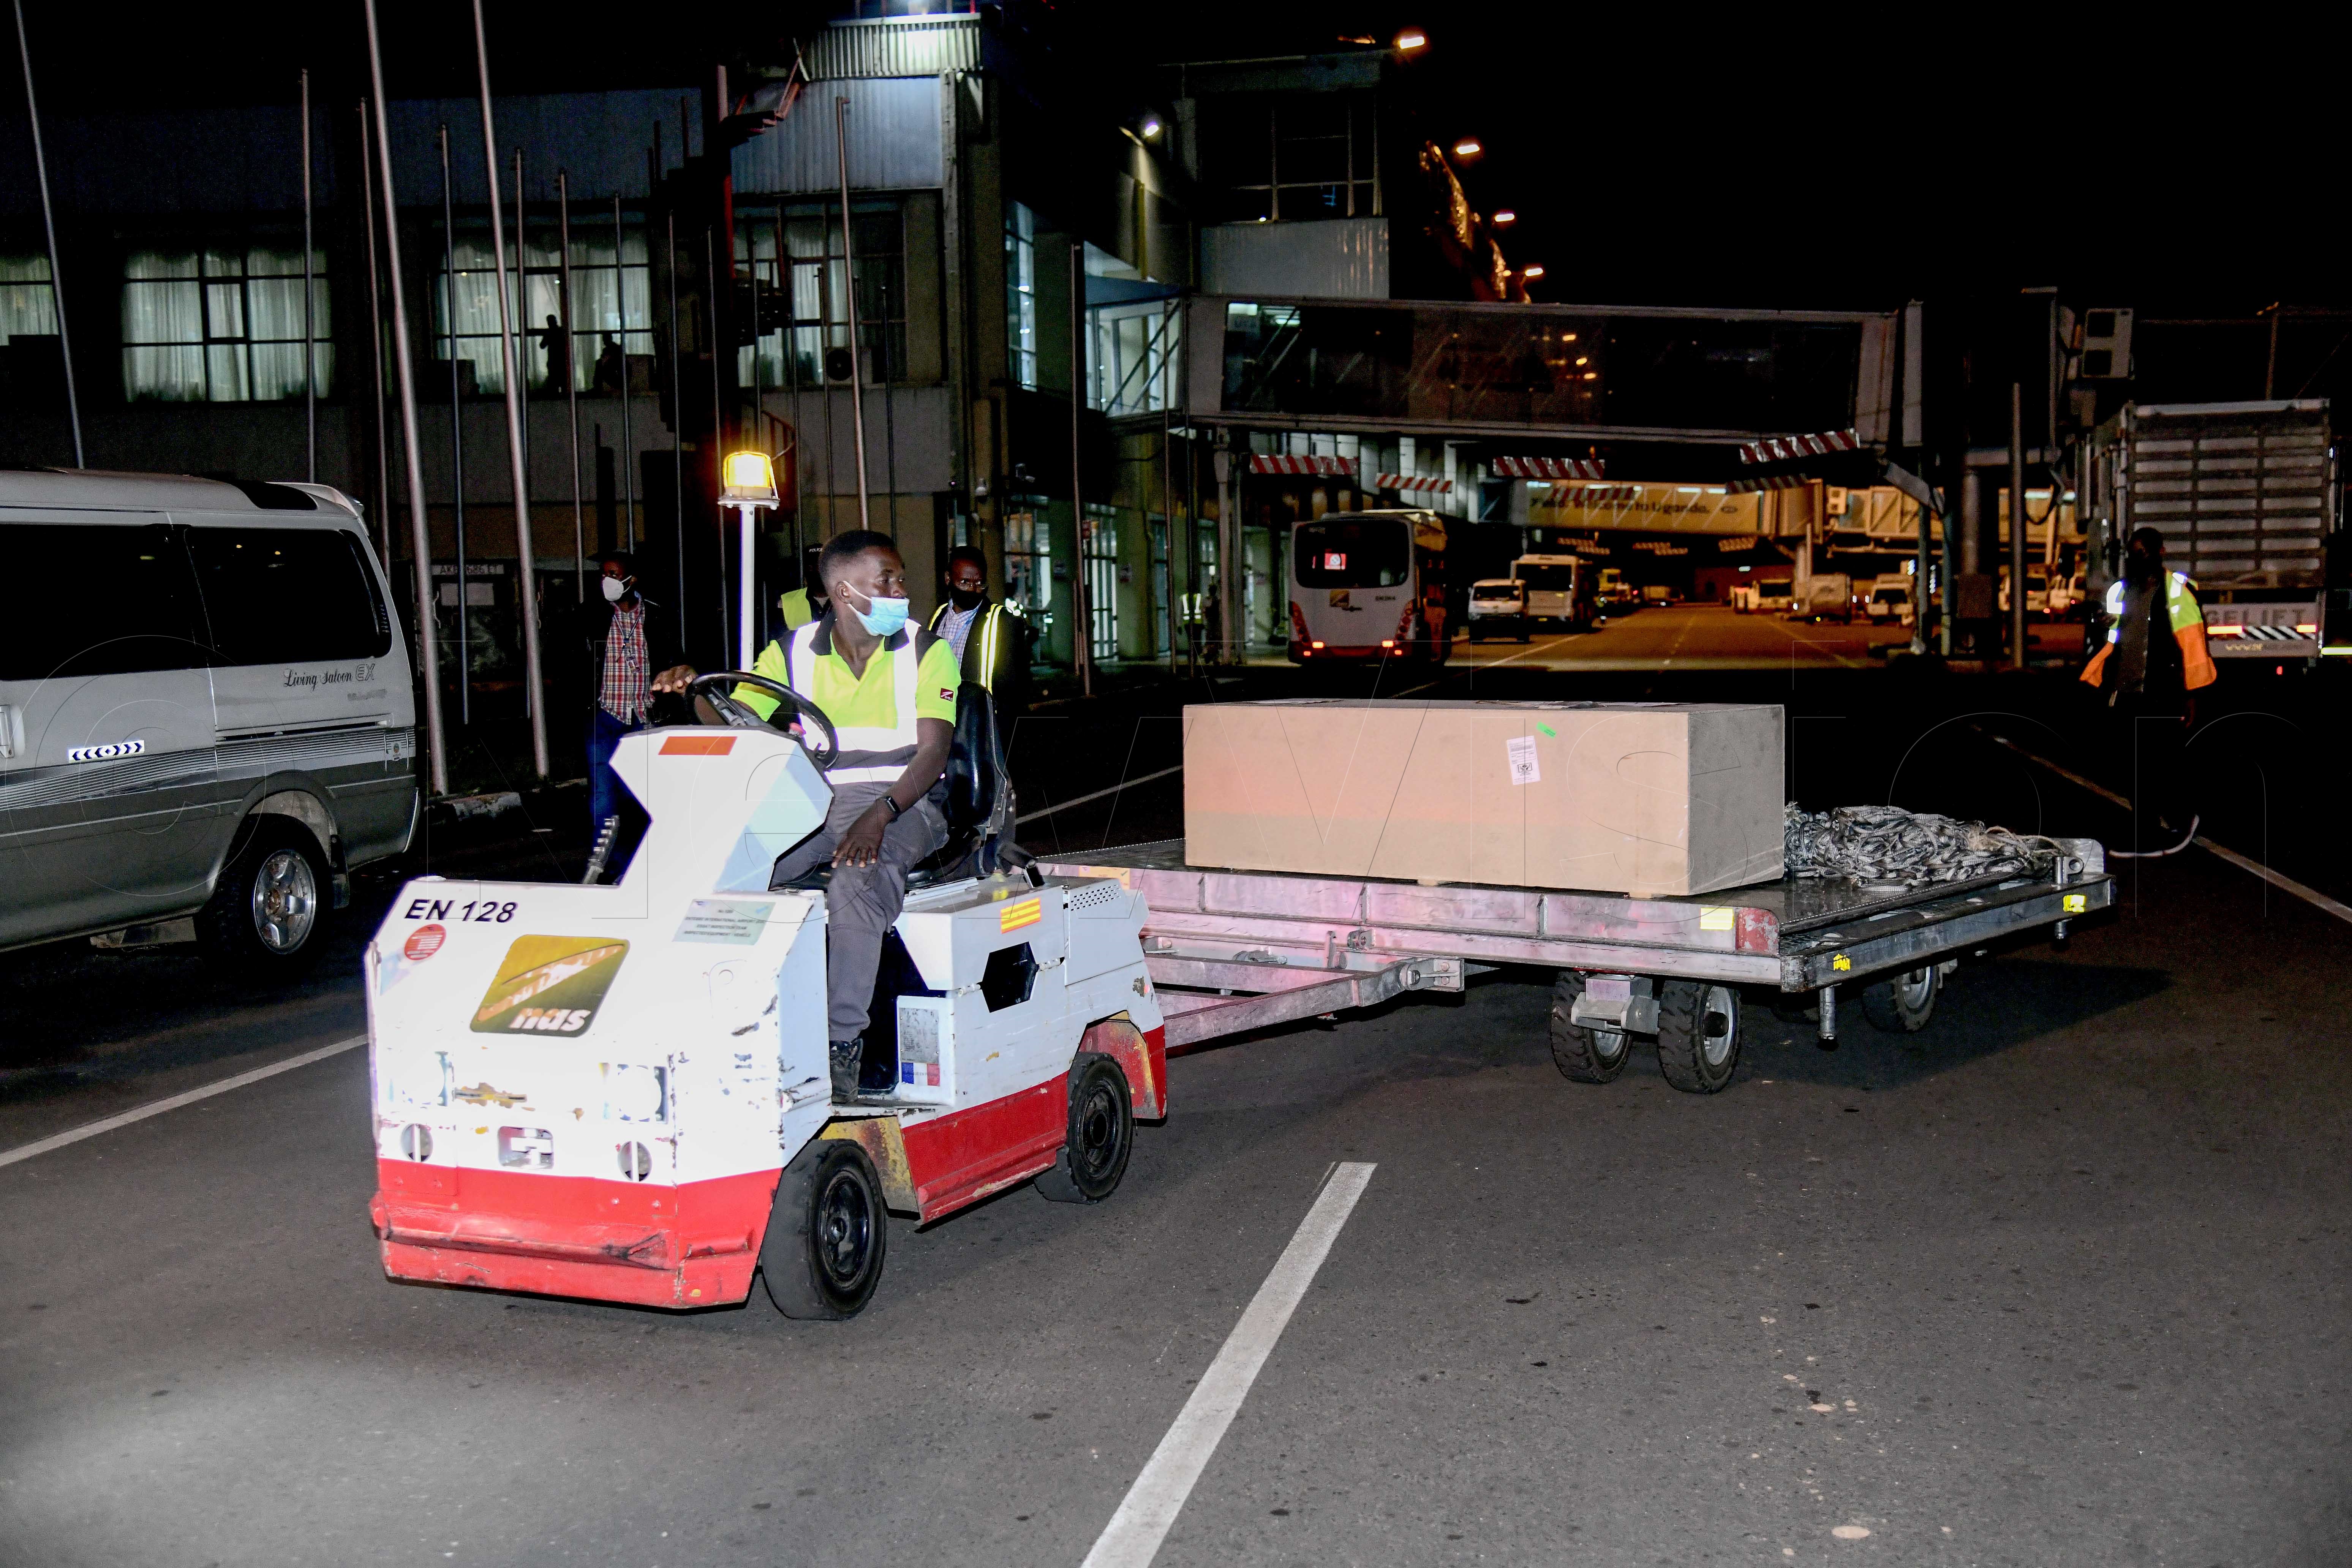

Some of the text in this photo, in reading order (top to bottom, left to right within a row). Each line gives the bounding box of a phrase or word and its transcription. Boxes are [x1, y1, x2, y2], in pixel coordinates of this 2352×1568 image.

[284, 668, 318, 692] Living
[356, 663, 375, 681] EX
[405, 899, 518, 923] EN 128
[509, 1007, 592, 1032] nas
